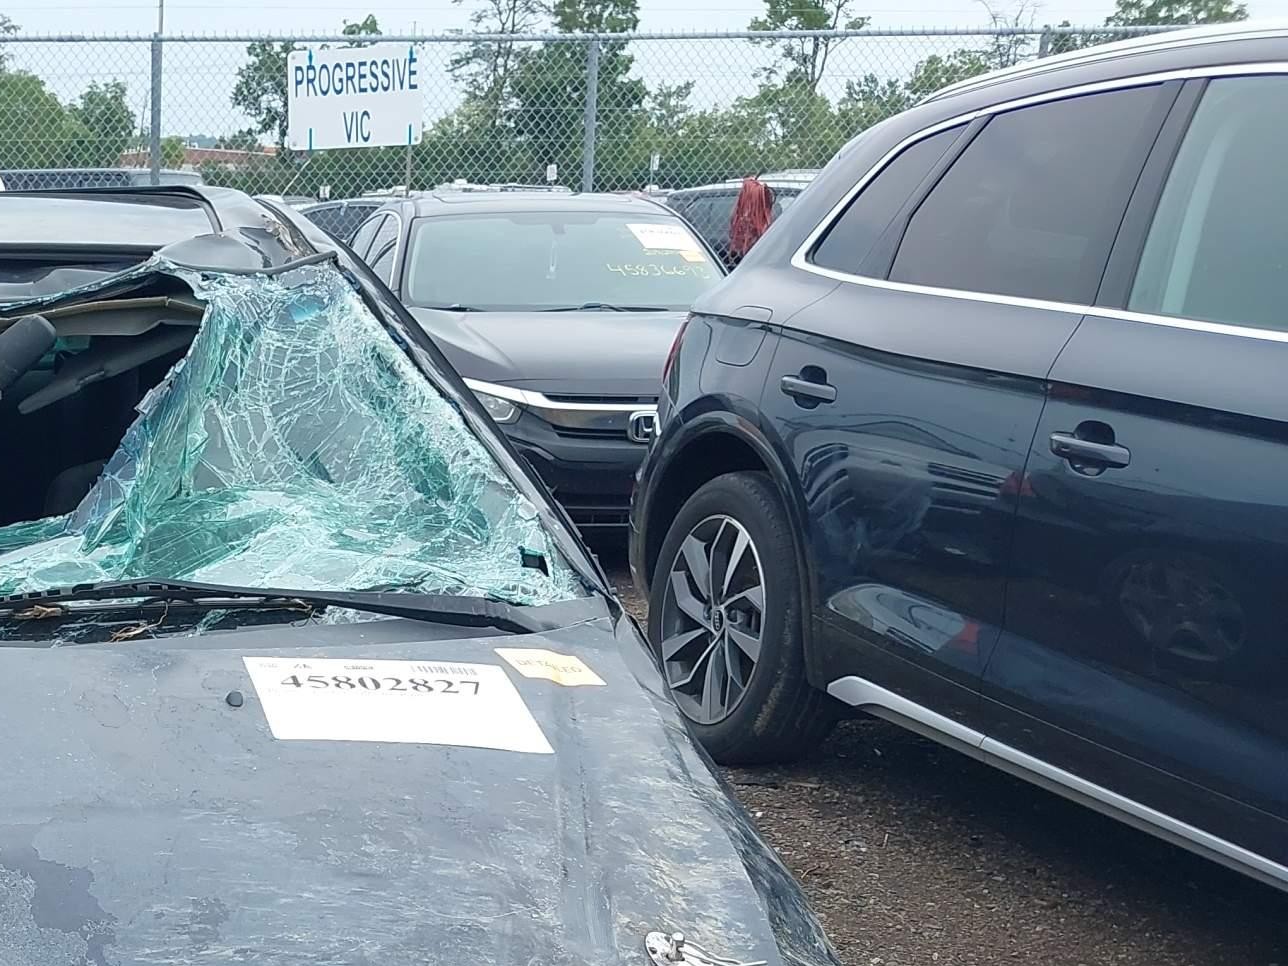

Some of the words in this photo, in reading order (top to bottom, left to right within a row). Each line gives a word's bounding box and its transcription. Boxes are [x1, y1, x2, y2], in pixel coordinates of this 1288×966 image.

[294, 58, 418, 98] PROGRESSIVE
[343, 110, 371, 143] VIC
[280, 674, 481, 697] 45802827
